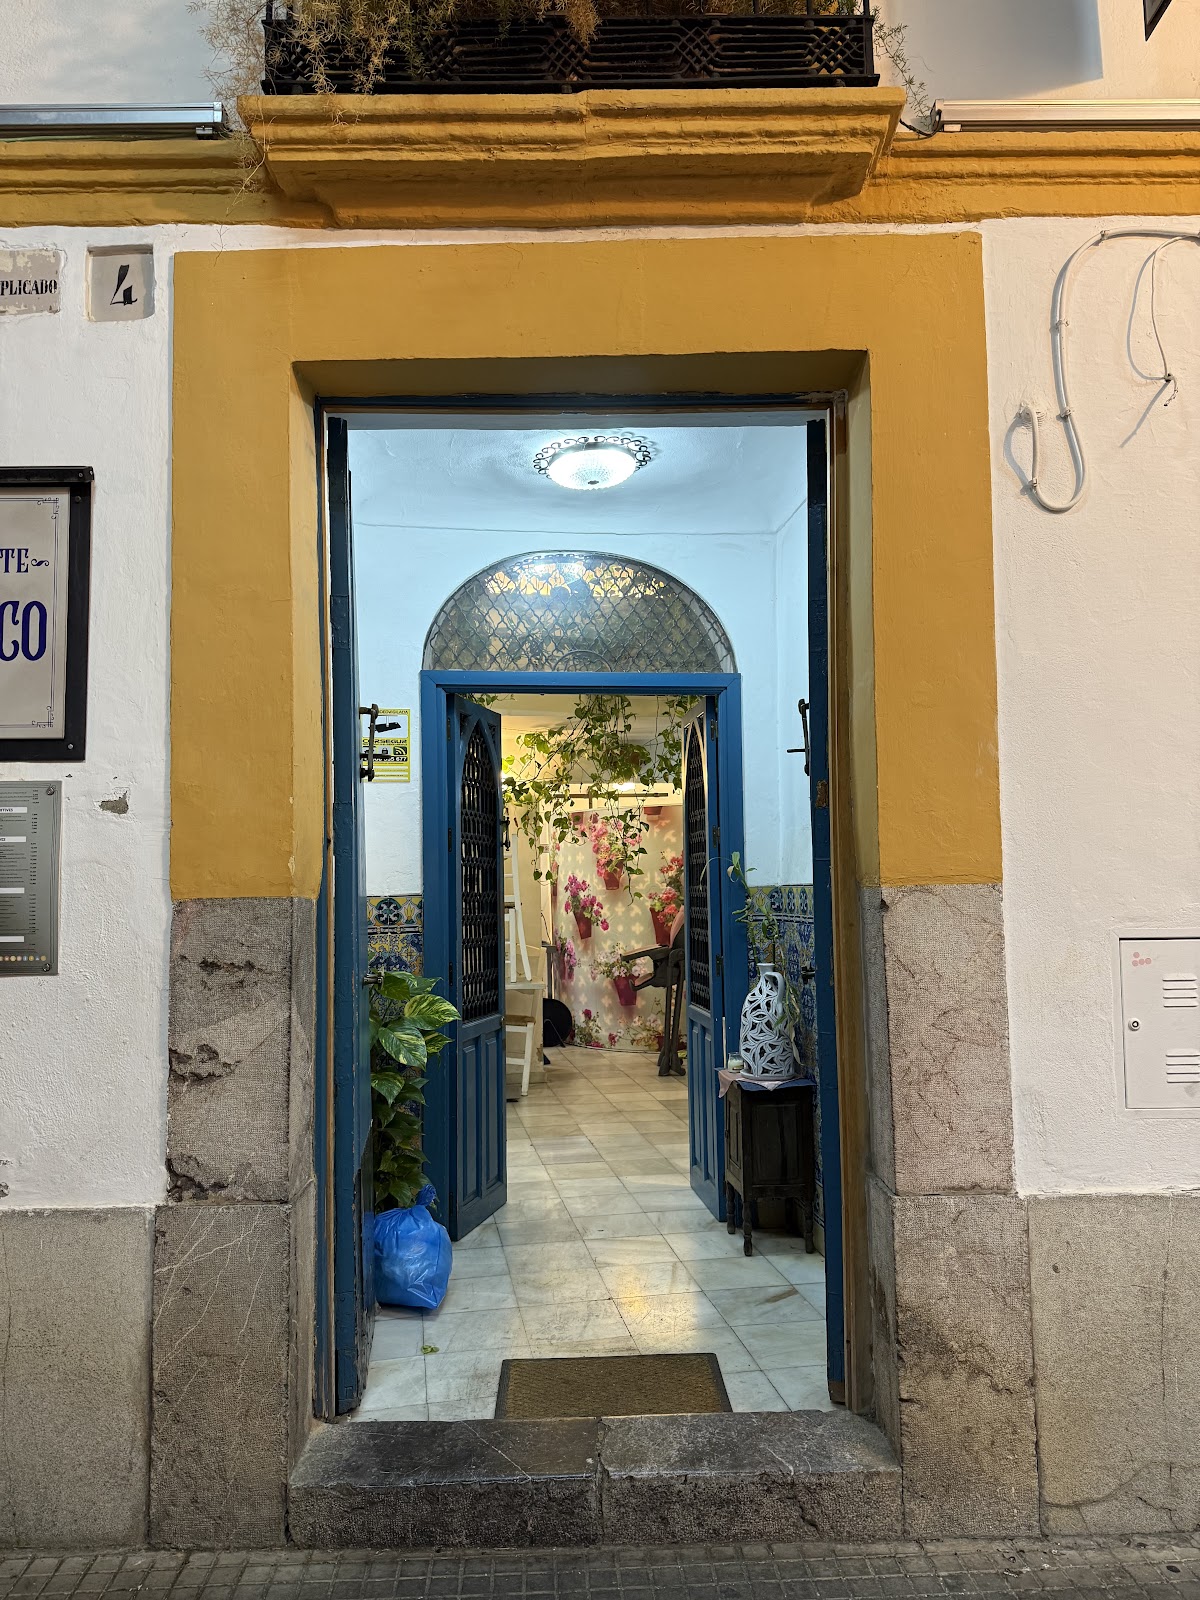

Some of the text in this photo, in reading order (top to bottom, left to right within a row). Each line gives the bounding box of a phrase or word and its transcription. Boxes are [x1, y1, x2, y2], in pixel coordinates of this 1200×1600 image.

[0, 279, 57, 296] PLICADO
[109, 264, 138, 306] 4
[0, 548, 29, 574] TE
[0, 600, 47, 662] CO
